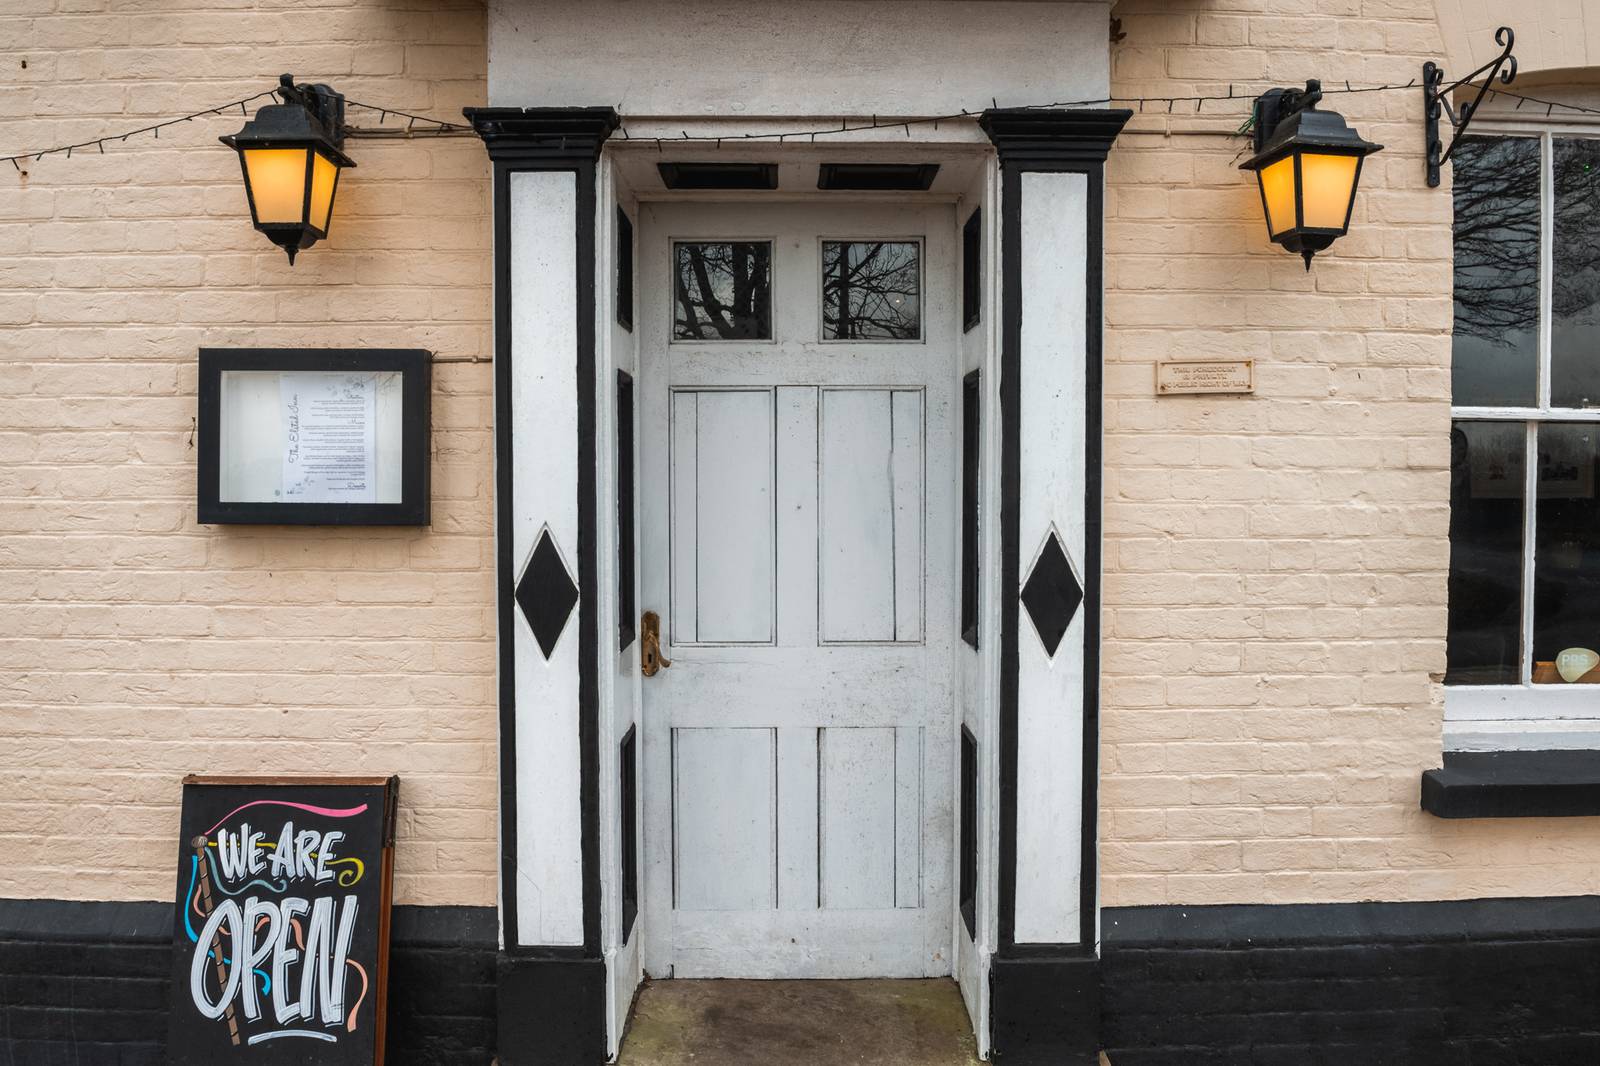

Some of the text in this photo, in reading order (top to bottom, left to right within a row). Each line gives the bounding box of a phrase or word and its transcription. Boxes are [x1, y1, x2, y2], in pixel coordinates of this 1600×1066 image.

[288, 444, 299, 464] The
[217, 820, 345, 883] WE ARE
[190, 895, 359, 1027] OPEN
